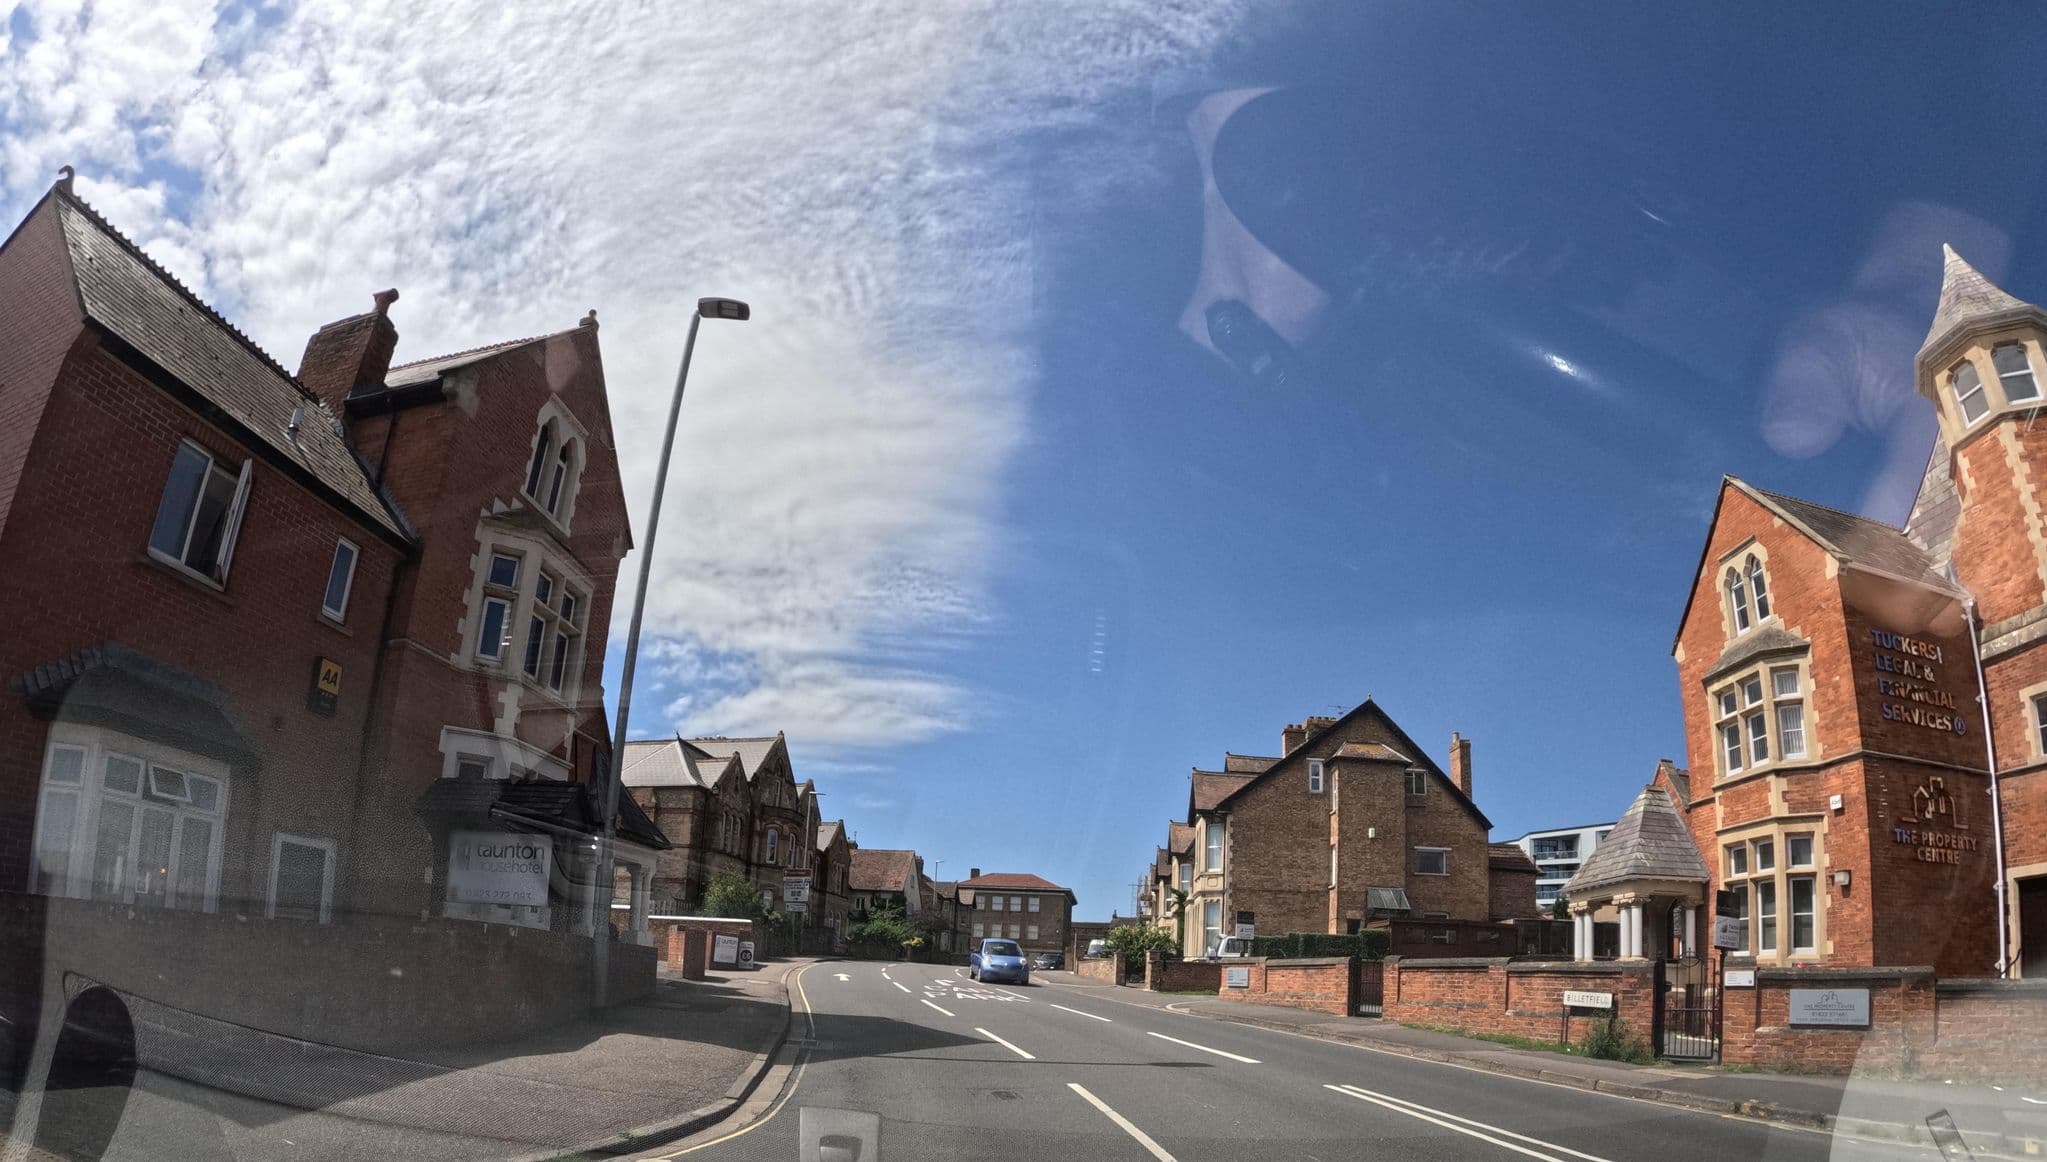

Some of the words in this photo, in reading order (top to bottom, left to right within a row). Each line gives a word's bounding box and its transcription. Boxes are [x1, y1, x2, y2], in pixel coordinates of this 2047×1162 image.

[321, 668, 338, 687] AA
[1924, 665, 1936, 682] &
[1878, 676, 1957, 711] FINANCIAL
[1882, 702, 1952, 731] SERVICES
[1894, 828, 1918, 845] THE
[1921, 831, 1977, 851] PROPERTY
[477, 842, 545, 860] taunton
[1917, 847, 1960, 865] CENTRE
